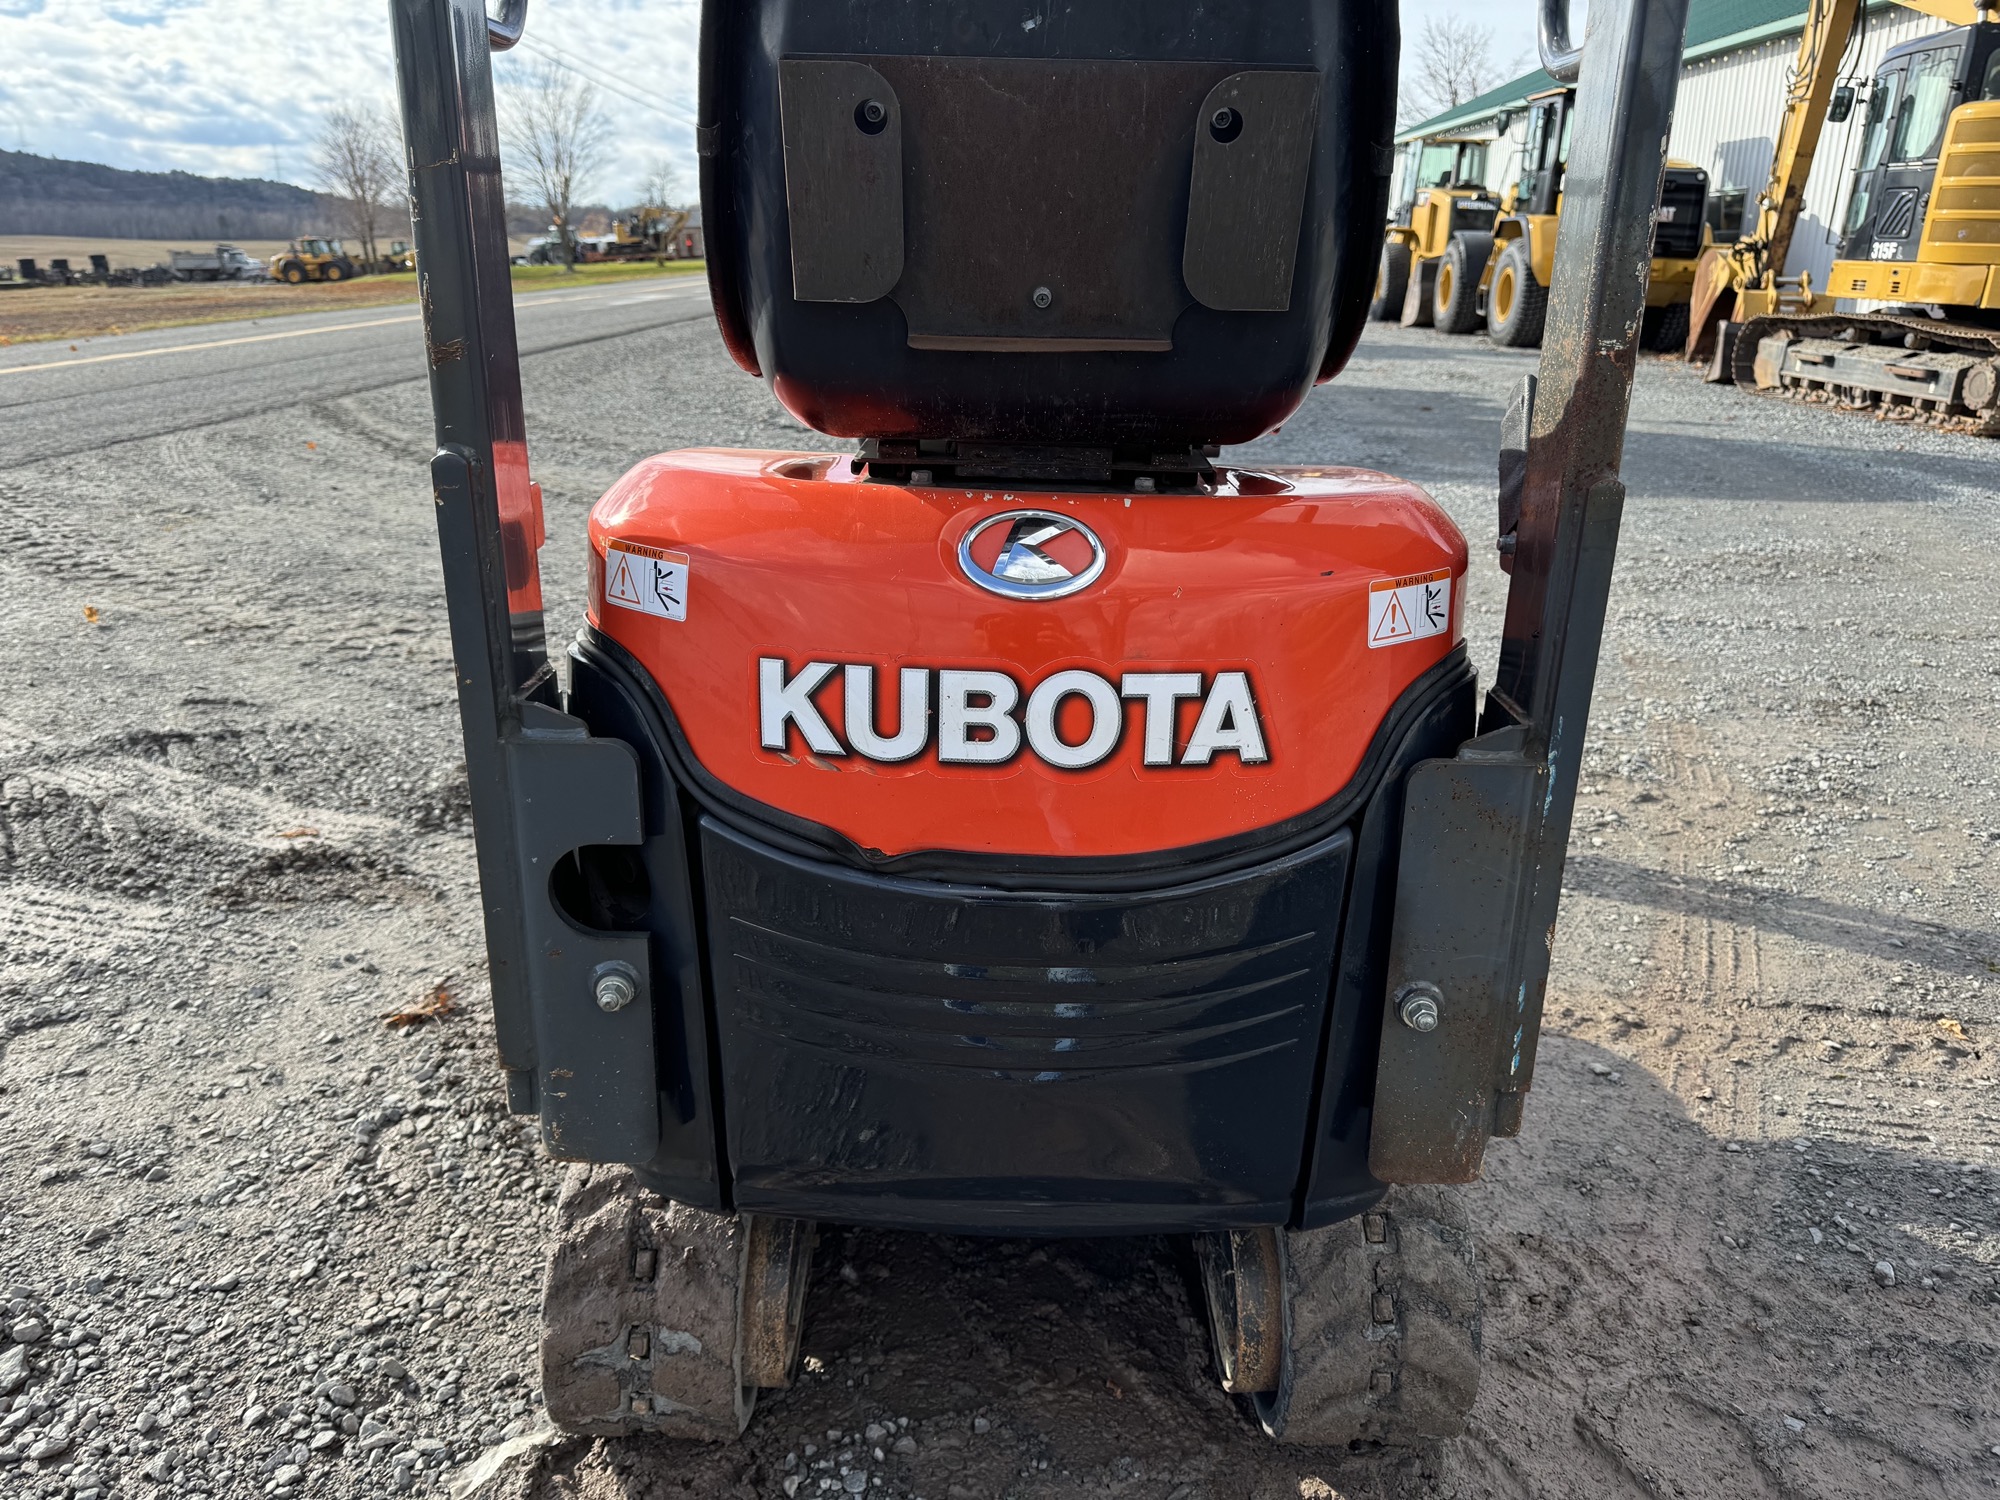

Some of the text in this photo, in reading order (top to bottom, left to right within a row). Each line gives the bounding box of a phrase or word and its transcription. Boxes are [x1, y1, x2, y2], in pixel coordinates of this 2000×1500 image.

[1871, 241, 1898, 259] 315F
[625, 544, 664, 560] WARNING
[1395, 573, 1434, 588] WARNING
[759, 657, 1268, 769] KUBOTA
